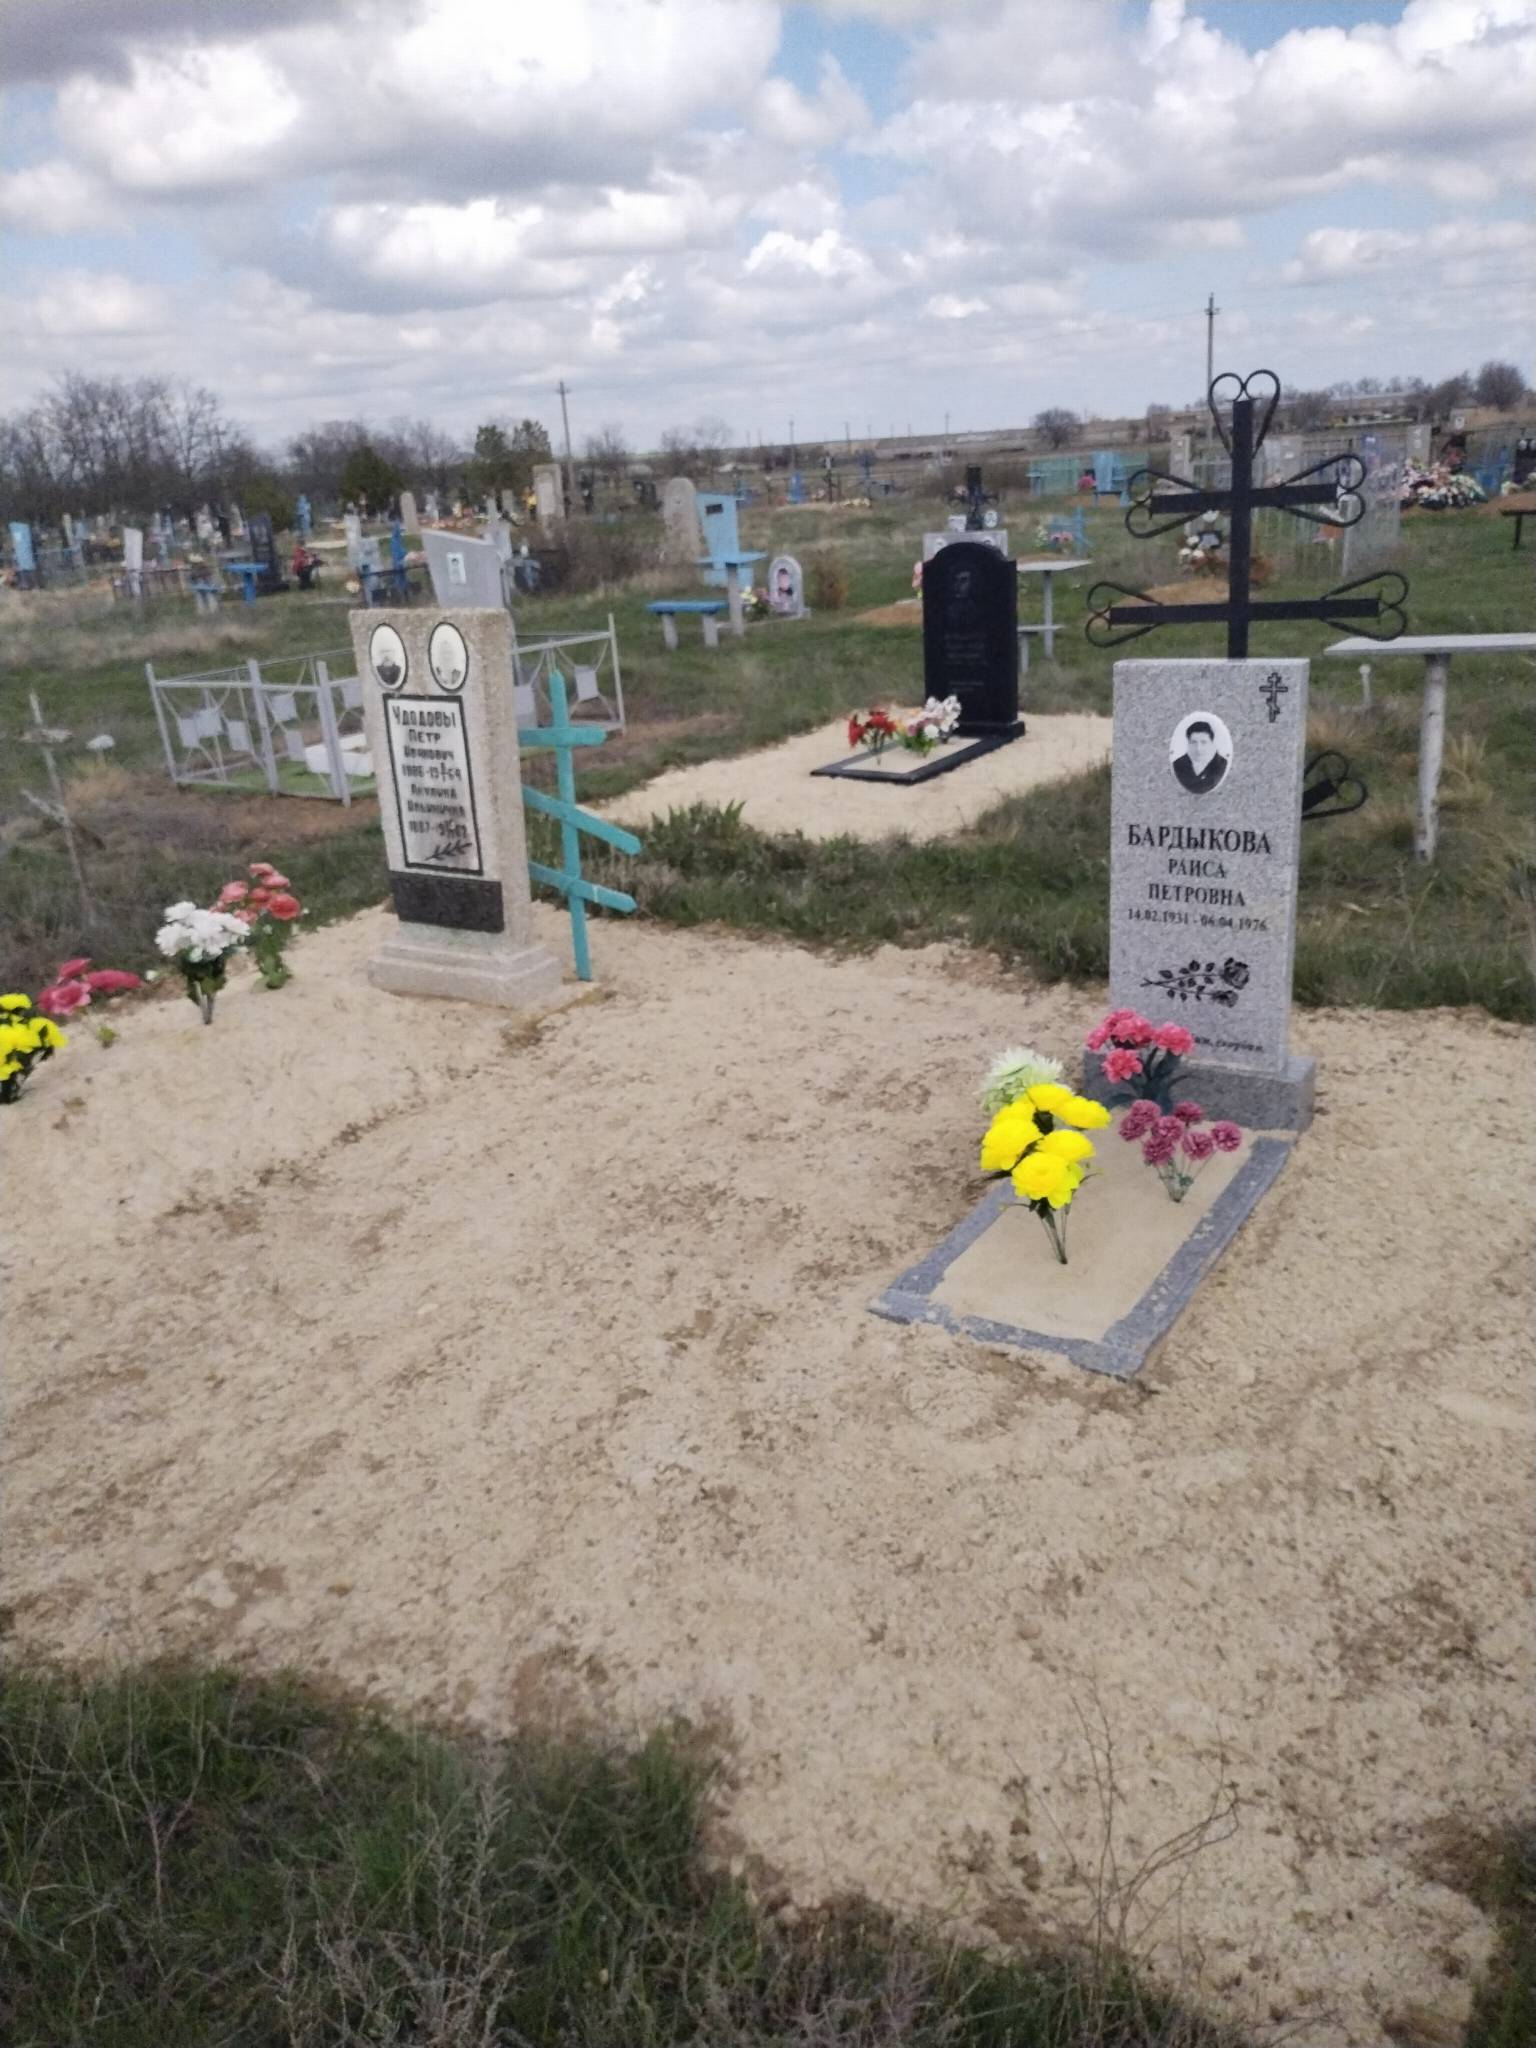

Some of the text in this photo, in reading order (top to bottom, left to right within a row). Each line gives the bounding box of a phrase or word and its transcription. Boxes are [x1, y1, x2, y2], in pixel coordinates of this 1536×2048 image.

[1127, 824, 1272, 855] БАРДЫКОВА
[1168, 858, 1227, 879] РАИСА
[1148, 883, 1246, 907] ПЕТРОВНА
